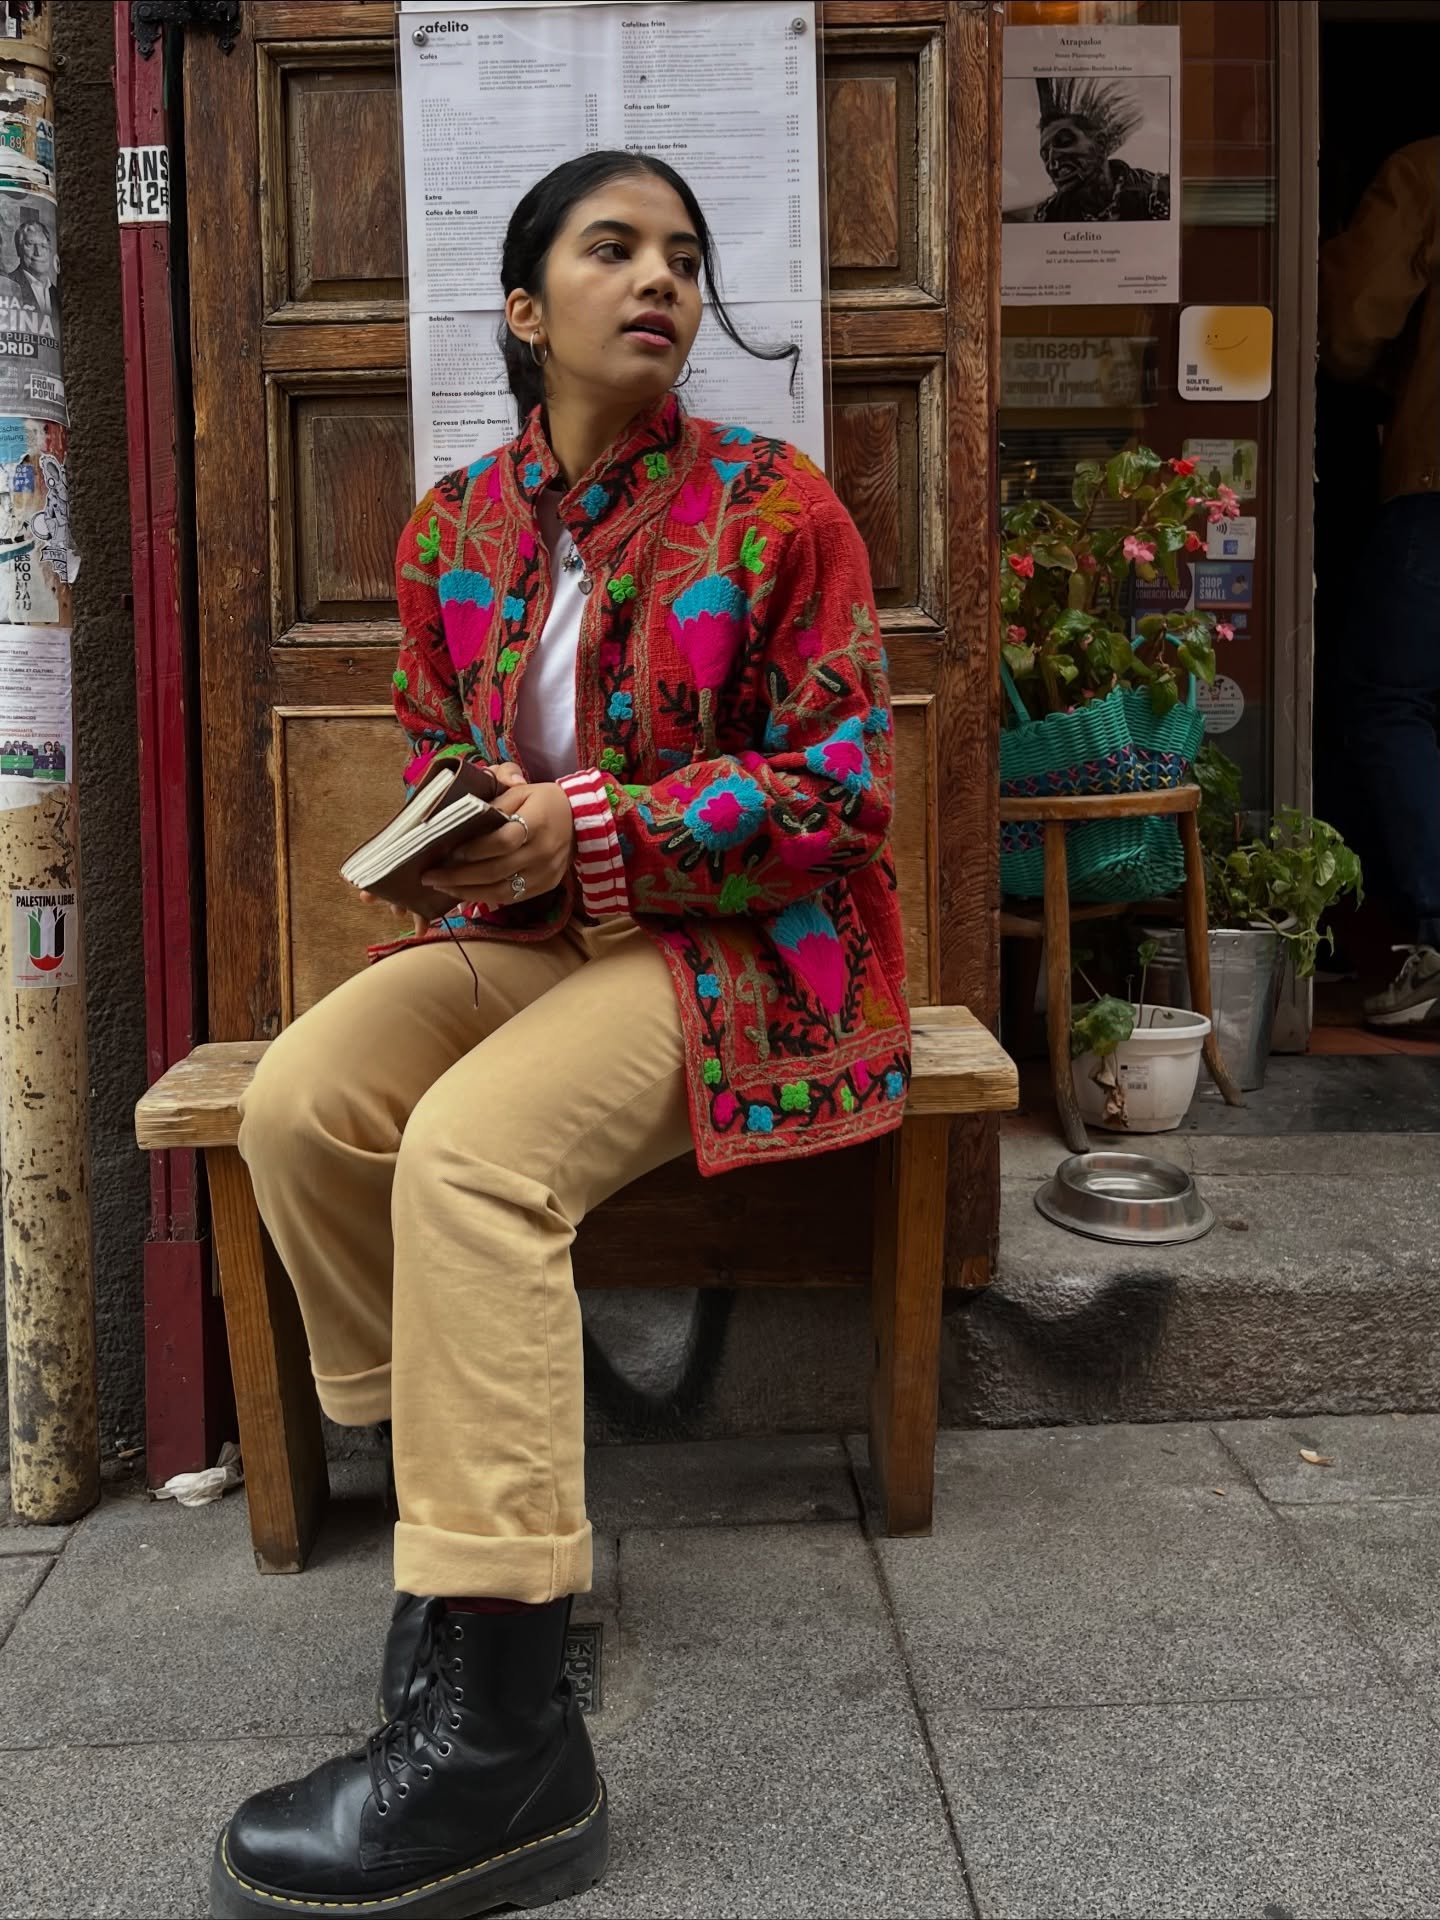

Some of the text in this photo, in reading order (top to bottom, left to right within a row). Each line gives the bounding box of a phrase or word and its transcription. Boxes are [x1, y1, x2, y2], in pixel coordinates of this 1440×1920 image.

[419, 21, 469, 33] cafelito
[1059, 38, 1101, 47] Atrapados
[1063, 231, 1102, 242] Cafelito
[32, 379, 56, 393] FRONT
[1199, 576, 1222, 588] SHOP
[1167, 589, 1187, 599] LOCAL
[1199, 588, 1226, 600] SMALL
[16, 893, 75, 907] PALESTINA LIBRE
